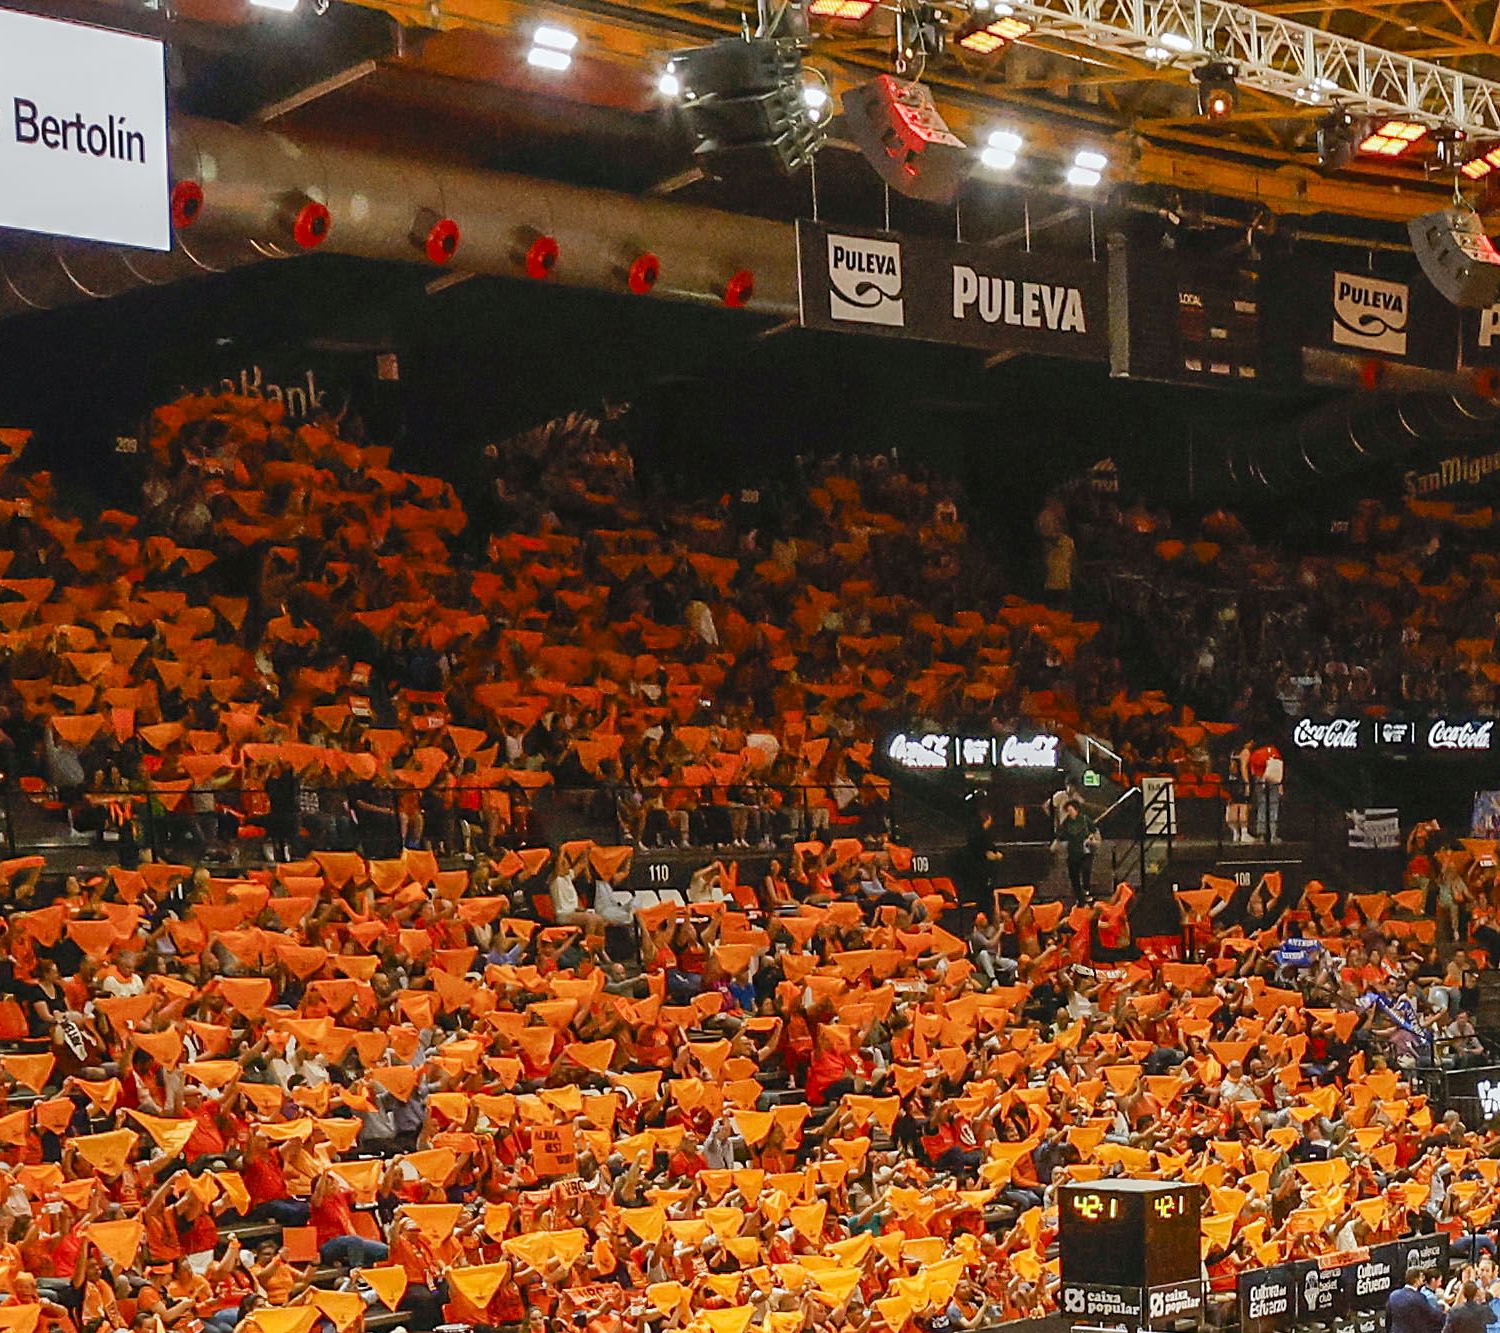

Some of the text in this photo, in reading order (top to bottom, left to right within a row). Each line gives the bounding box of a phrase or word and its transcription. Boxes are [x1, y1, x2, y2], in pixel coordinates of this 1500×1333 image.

[15, 98, 146, 163] Bertolín
[833, 245, 897, 277] PULEVA
[953, 266, 1086, 332] PULEVA
[1339, 282, 1403, 313] PULEVA
[1294, 719, 1360, 748] Coca-Cola
[1428, 720, 1493, 748] Coca-Cola
[912, 857, 928, 872] 109
[1235, 872, 1251, 886] 108
[1357, 1262, 1384, 1281] Cultura
[1250, 1284, 1278, 1302] Cultura
[1319, 1279, 1343, 1294] basket
[1356, 1276, 1391, 1296] Esfuerzo
[1087, 1290, 1118, 1303] caixa
[1165, 1289, 1189, 1302] caixa
[1318, 1289, 1334, 1304] club
[1087, 1300, 1140, 1318] popular
[1164, 1298, 1200, 1315] popular
[1249, 1298, 1287, 1320] Esfuerzo
